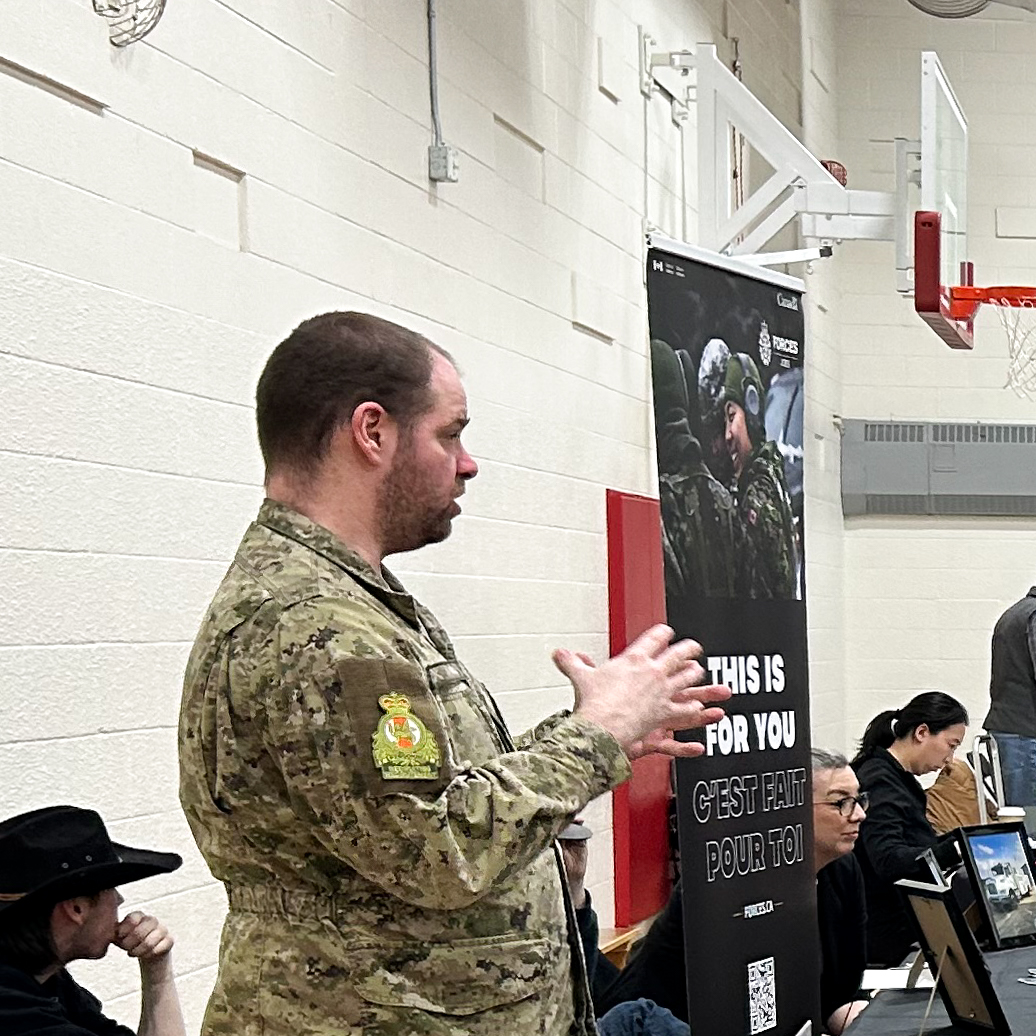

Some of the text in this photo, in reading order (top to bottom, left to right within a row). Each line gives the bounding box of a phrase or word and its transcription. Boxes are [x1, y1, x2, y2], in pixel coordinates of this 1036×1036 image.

[772, 335, 799, 355] FORCES
[707, 653, 786, 695] THIS IS
[706, 710, 796, 757] FOR YOU
[692, 767, 806, 824] C'EST FAIT
[705, 823, 804, 882] POUR TOI
